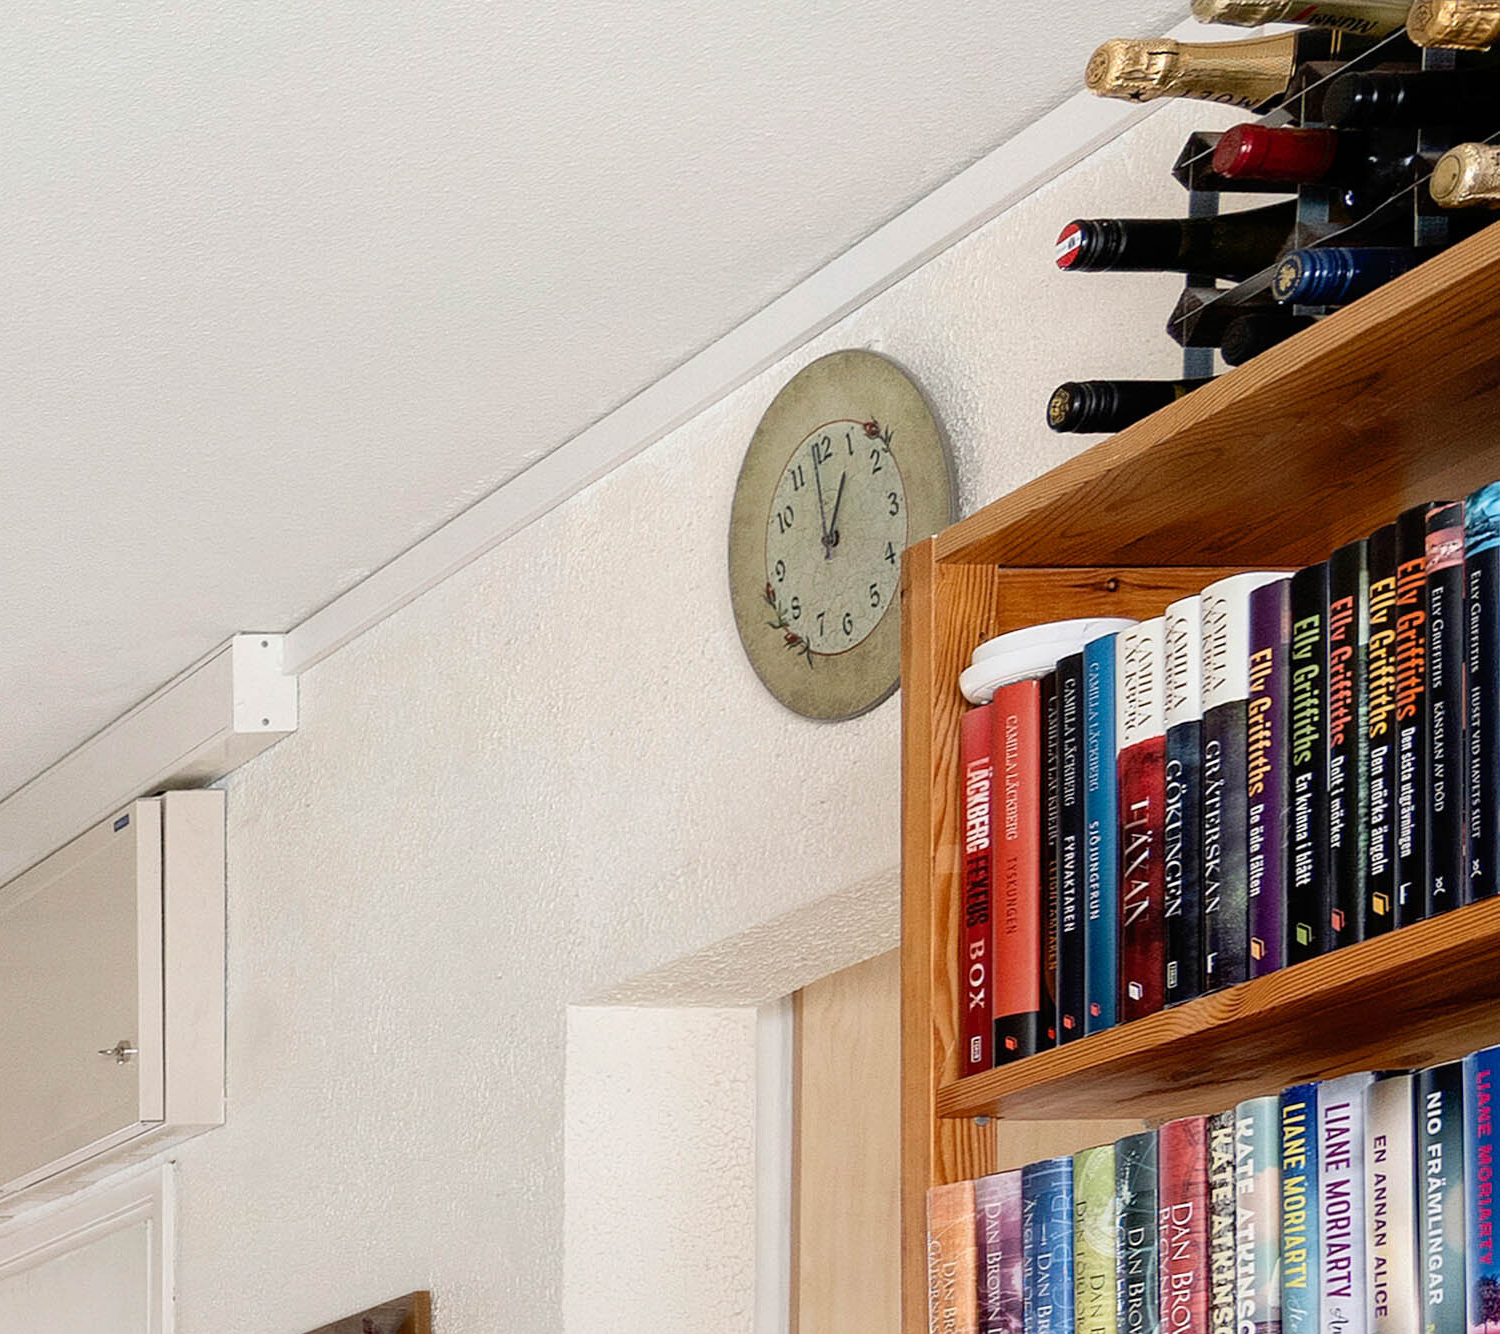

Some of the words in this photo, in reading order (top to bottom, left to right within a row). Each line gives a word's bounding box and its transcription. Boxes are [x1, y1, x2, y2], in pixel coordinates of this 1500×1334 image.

[1397, 560, 1426, 603] Elly
[1249, 648, 1271, 694] Elly
[1124, 798, 1151, 926] HÄXAN
[1166, 760, 1182, 918] GÖKUNGEN
[968, 940, 986, 1010] BOX
[1283, 1104, 1304, 1168] LIANE
[1325, 1104, 1350, 1172] LIANE
[1427, 1091, 1441, 1135] NIO
[1374, 1136, 1386, 1162] EN
[986, 1203, 1001, 1245] DAN
[1171, 1203, 1192, 1259] DAN
[1283, 1180, 1306, 1289] MORIARTY
[1326, 1184, 1351, 1298] MORIARTY
[1374, 1172, 1386, 1247] ANNAN
[1427, 1146, 1442, 1305] FRÄMLINGAR
[987, 1253, 1001, 1322] BROWN
[1374, 1255, 1387, 1318] ALICE
